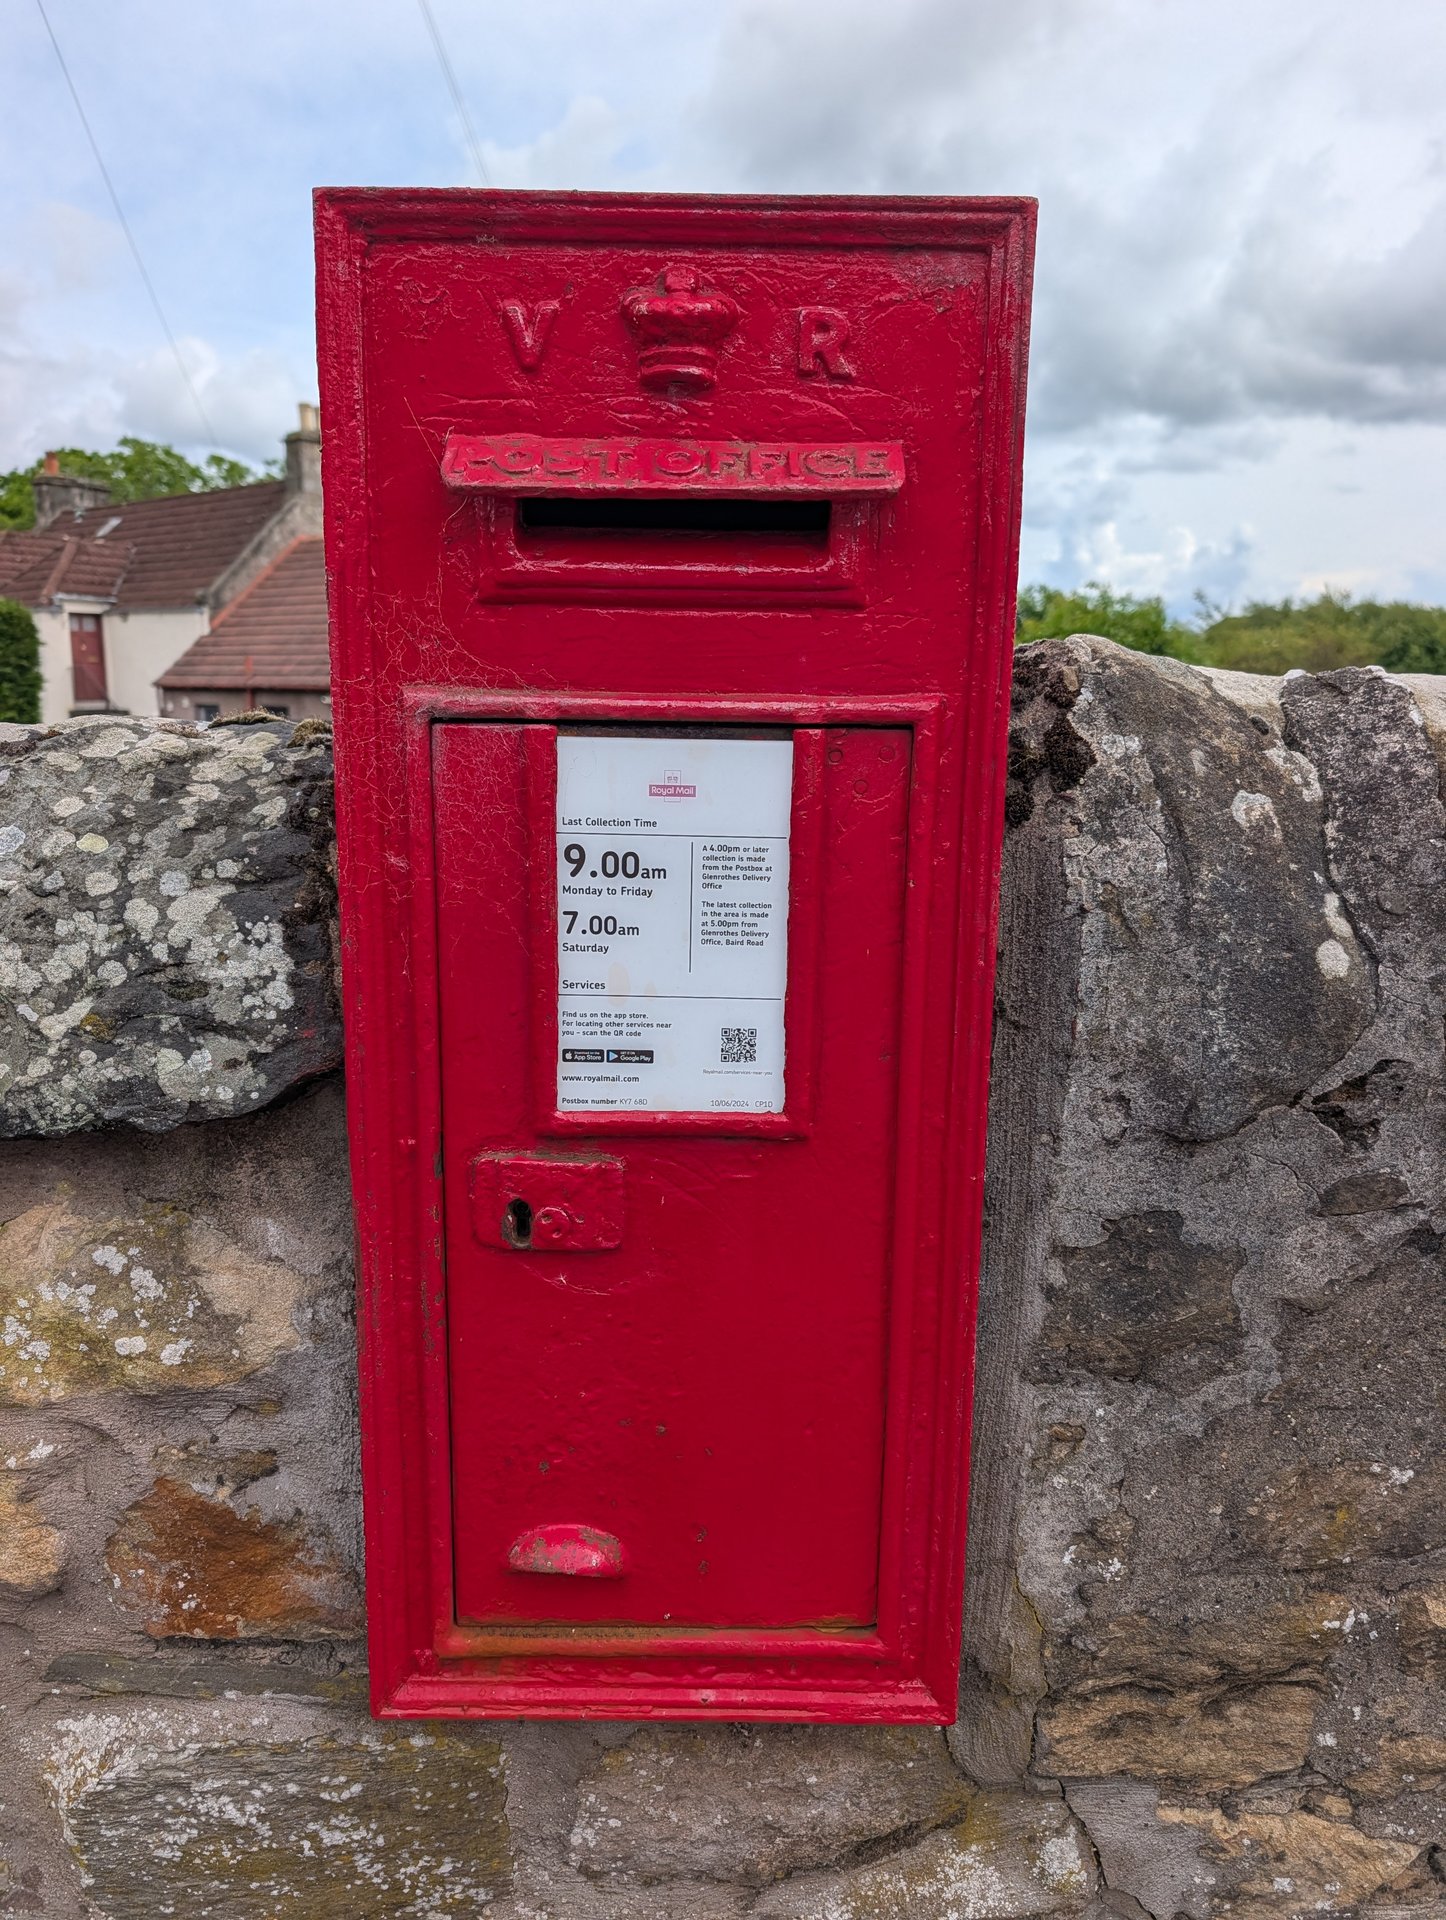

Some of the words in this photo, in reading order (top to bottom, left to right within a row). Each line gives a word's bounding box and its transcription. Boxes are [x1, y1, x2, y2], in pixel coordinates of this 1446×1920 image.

[501, 299, 560, 372] V
[799, 306, 857, 381] R
[451, 447, 638, 477] POST
[655, 447, 893, 478] OFFICE
[652, 786, 674, 795] Royal
[562, 816, 582, 826] Last
[586, 817, 631, 827] Collection
[634, 818, 658, 828] Time
[709, 844, 740, 853] 4.00pm
[564, 843, 667, 880] 9.00am
[742, 874, 771, 882] Delivery
[562, 885, 603, 897] Monday
[606, 887, 617, 896] to
[621, 886, 653, 898] Friday
[562, 910, 640, 936] 7.00am
[710, 920, 739, 928] 5.00pm
[741, 930, 769, 938] Delivery
[562, 942, 609, 954] Saturday
[562, 980, 606, 990] Services
[562, 1075, 640, 1083] www.royalmail.com
